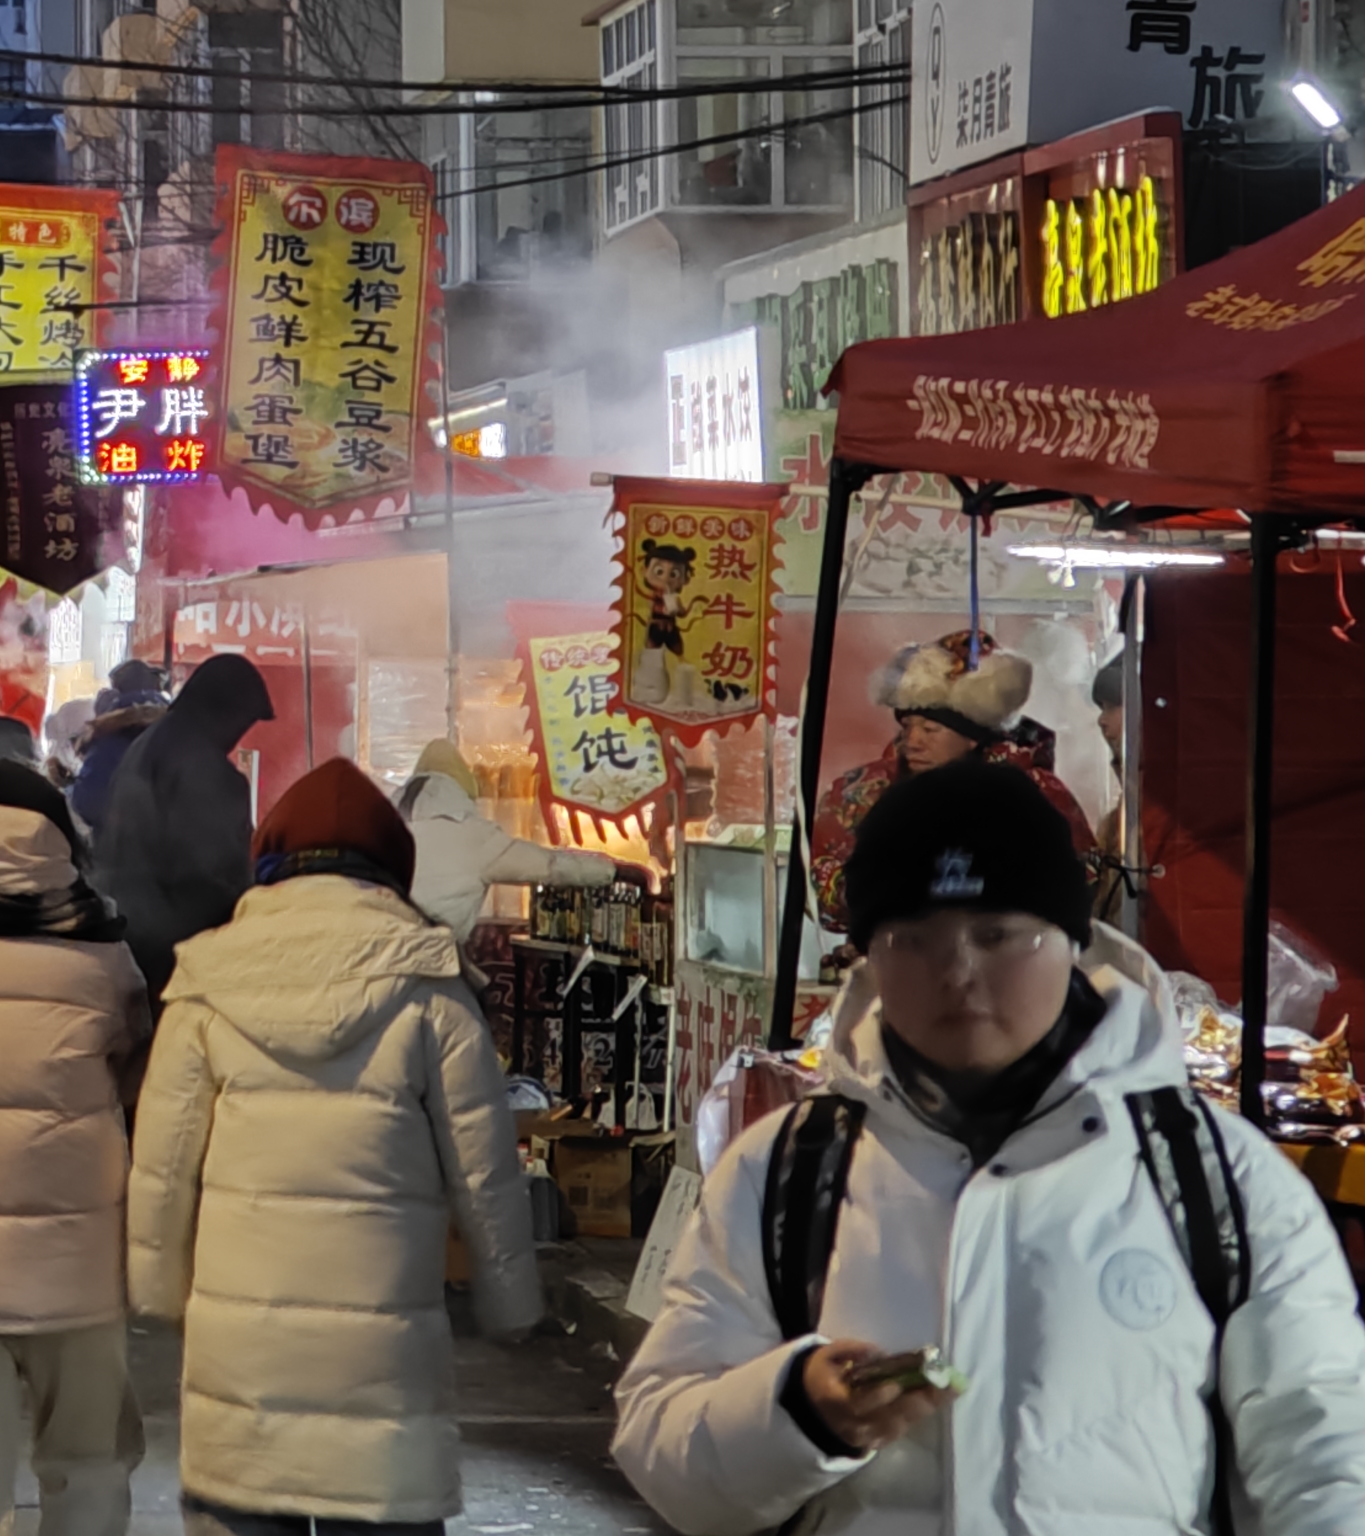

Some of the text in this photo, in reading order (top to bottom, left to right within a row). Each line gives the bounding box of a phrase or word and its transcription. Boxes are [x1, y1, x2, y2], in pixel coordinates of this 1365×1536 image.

[9, 221, 56, 245] 特色
[287, 192, 374, 227] 尔滨
[240, 232, 313, 469] 脆皮鲜肉蛋堡
[332, 240, 406, 474] 现榨五谷豆浆
[91, 385, 209, 438] 尹胖
[97, 439, 205, 473] 油炸
[647, 514, 752, 540] 新鲜美味
[700, 543, 758, 680] 热牛奶
[564, 674, 639, 773] 馄饨
